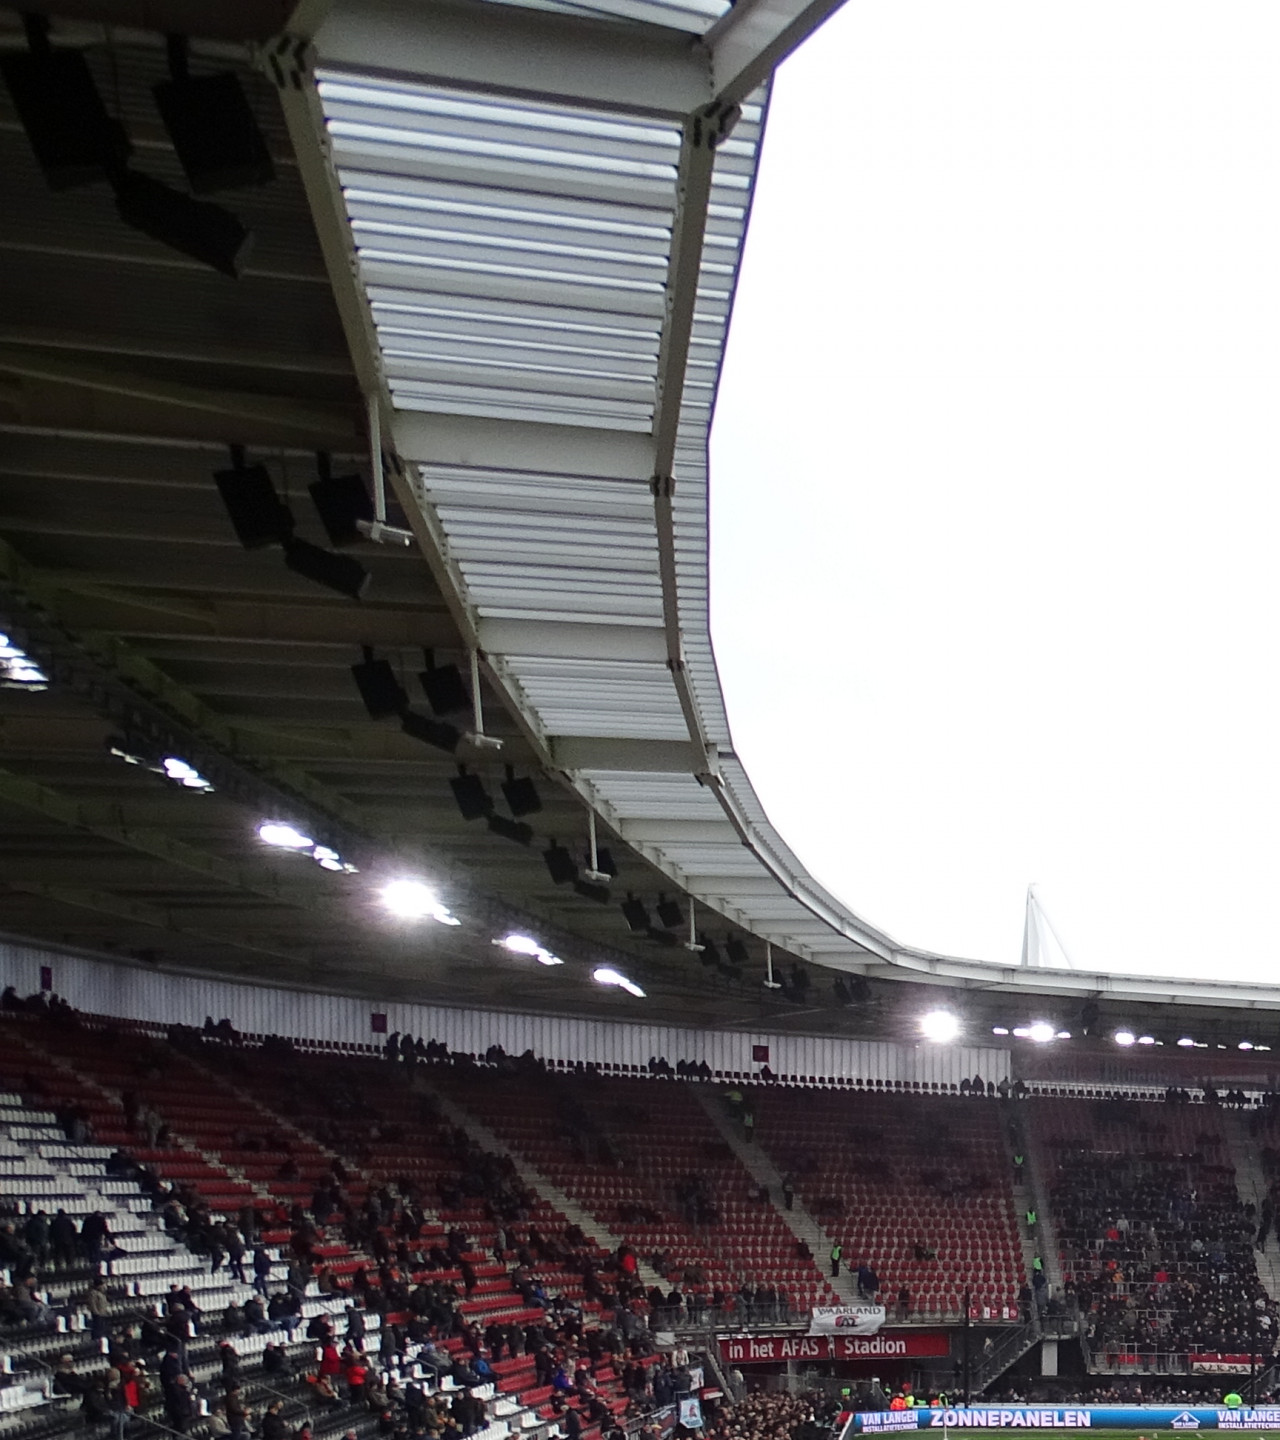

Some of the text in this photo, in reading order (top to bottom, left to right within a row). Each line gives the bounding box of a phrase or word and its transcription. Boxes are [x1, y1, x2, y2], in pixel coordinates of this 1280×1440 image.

[818, 1307, 882, 1315] WAARLAND
[729, 1338, 819, 1358] in het AFAS
[844, 1337, 906, 1354] Stadion
[862, 1411, 918, 1425] VAN LANGEN
[931, 1410, 1091, 1428] ZONNEPANELEN
[1218, 1411, 1241, 1422] VAN
